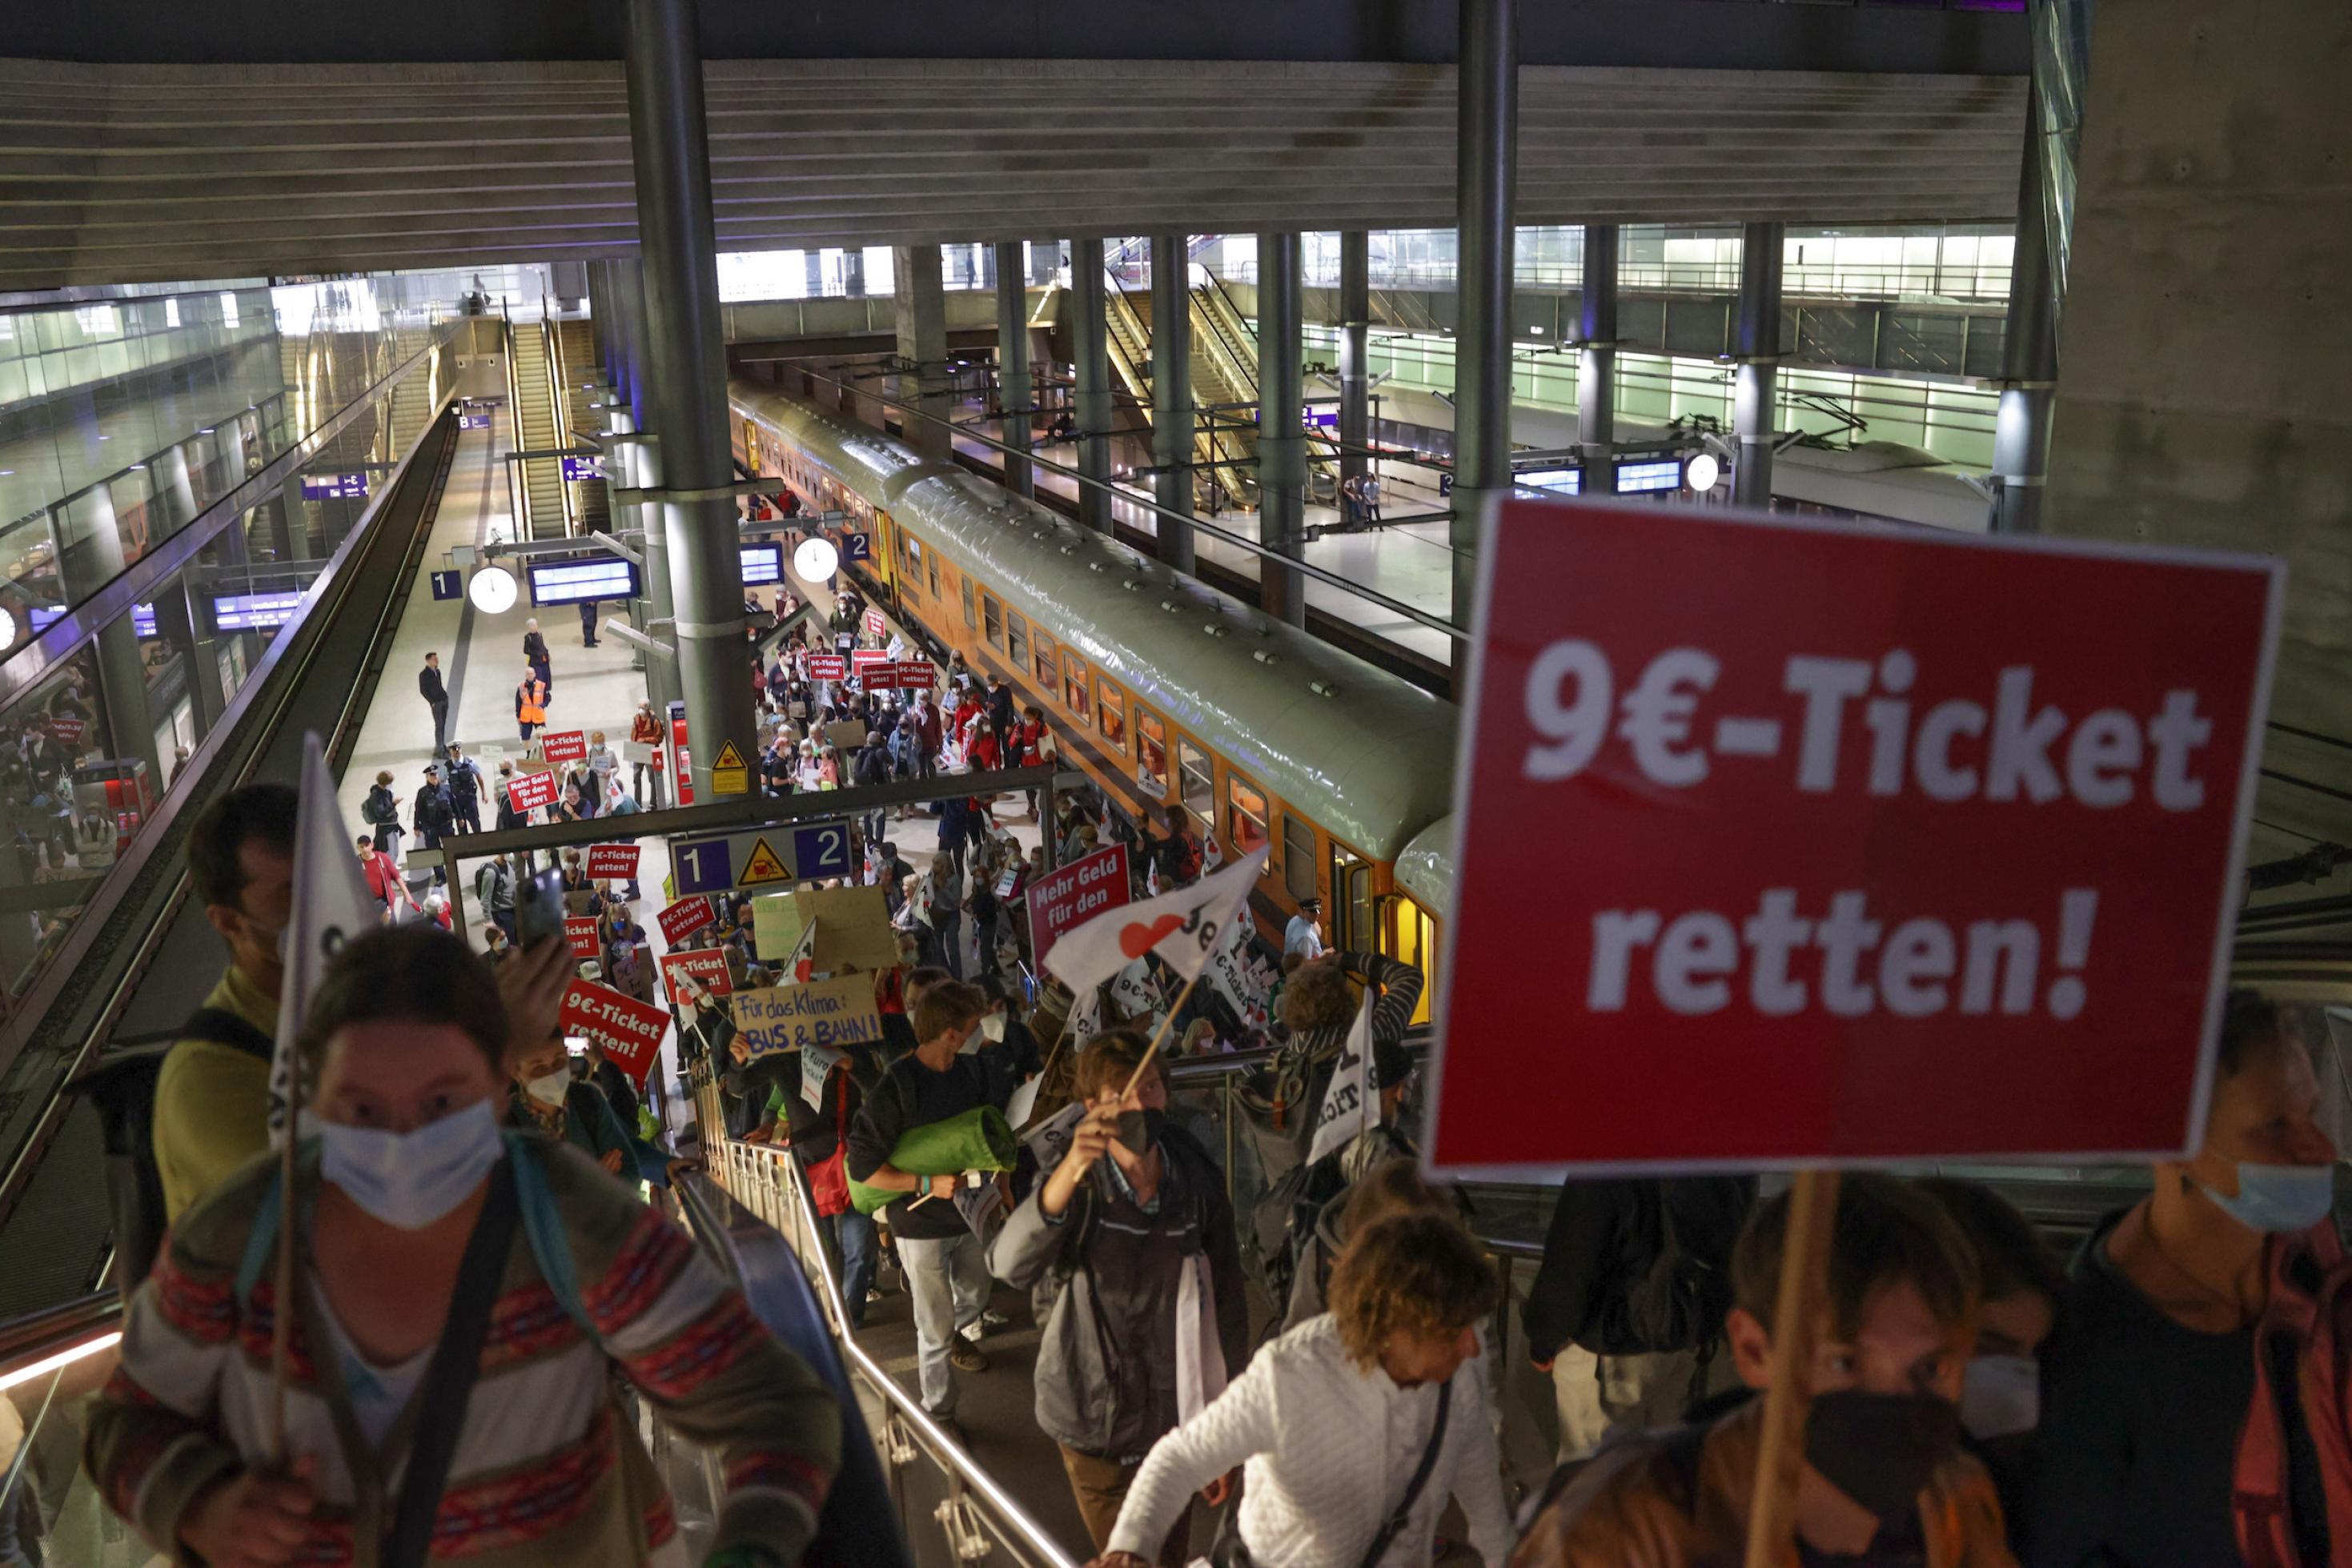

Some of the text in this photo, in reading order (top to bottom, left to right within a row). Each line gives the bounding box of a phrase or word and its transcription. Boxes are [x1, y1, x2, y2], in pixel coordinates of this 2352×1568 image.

[460, 416, 469, 429] B
[853, 535, 866, 555] 2
[435, 573, 446, 594] 1
[810, 659, 843, 667] 9€-Ticket
[898, 667, 933, 675] 9€-Ticket
[1521, 638, 2213, 812] 9€-Ticket
[544, 735, 583, 748] 9€-Ticket
[550, 745, 580, 756] retten!
[510, 773, 550, 791] Mehr Geld
[517, 785, 548, 797] für den
[591, 851, 637, 860] 9€-Ticket
[817, 830, 841, 866] 2
[595, 863, 628, 872] retten!
[683, 848, 701, 883] 1
[1036, 875, 1074, 908] Mehr
[1078, 853, 1118, 884] Geld
[662, 896, 706, 928] 9€-Ticket
[1047, 888, 1108, 928] für den
[671, 911, 704, 936] retten!
[666, 957, 724, 975] 9-Ticket
[1585, 888, 2099, 1021] retten!
[736, 988, 846, 1022] Für das Klima:
[568, 993, 660, 1041] 9€-Ticket
[568, 1023, 640, 1057] retten!
[746, 1023, 789, 1054] BUS
[794, 1025, 810, 1047] &
